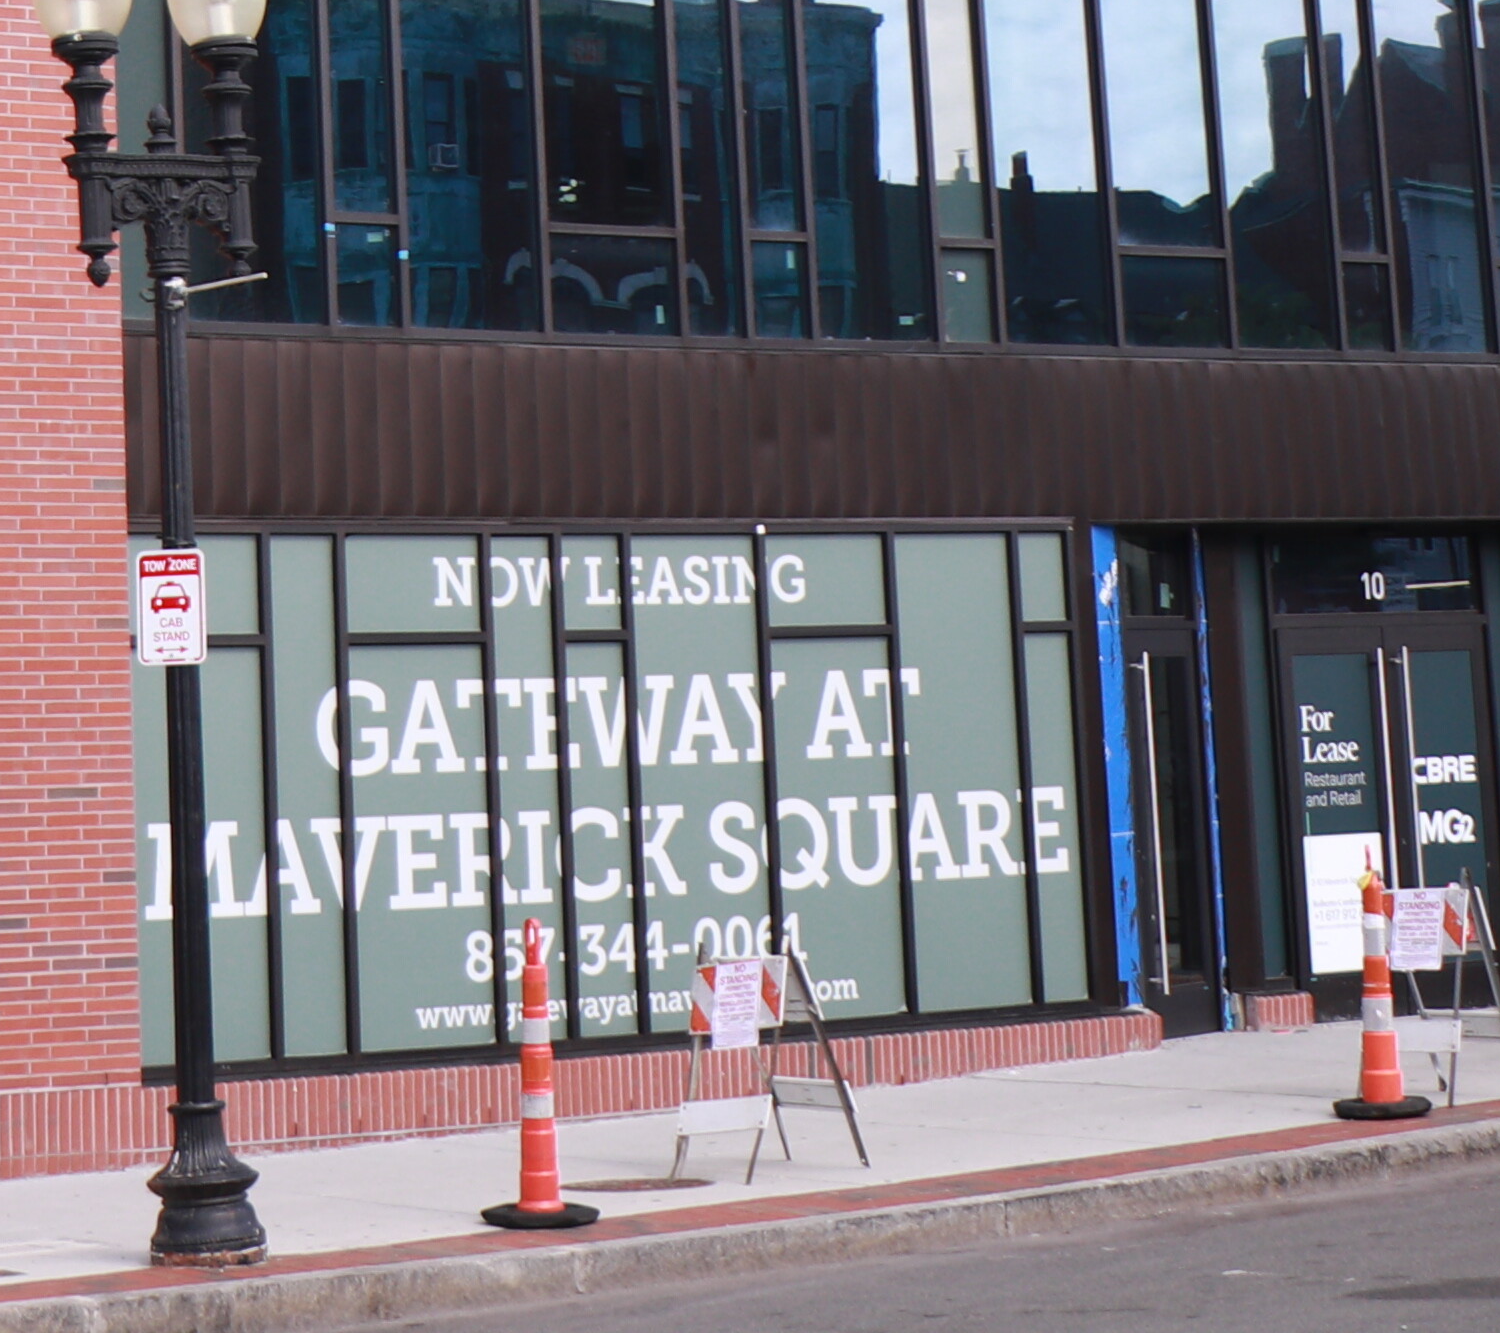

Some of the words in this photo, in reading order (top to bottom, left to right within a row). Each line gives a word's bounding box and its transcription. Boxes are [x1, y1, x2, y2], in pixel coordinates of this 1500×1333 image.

[143, 560, 166, 572] TOW
[168, 558, 197, 571] ZONE
[432, 555, 570, 607] NOW
[584, 554, 807, 606] LEASING
[1361, 572, 1385, 600] 10
[159, 617, 183, 628] CAB
[153, 631, 190, 642] STAND
[316, 672, 788, 776] GATEWAY
[806, 667, 920, 759] AT
[1300, 705, 1334, 733] For
[1302, 736, 1360, 763] Lease
[1305, 771, 1366, 787] Restaurant
[1412, 754, 1477, 785] CBRE
[1306, 791, 1328, 808] and
[1330, 789, 1363, 806] Retail
[1419, 809, 1477, 845] MG2
[145, 806, 688, 921] MAVERICK
[708, 786, 1070, 895] SQUARE
[1399, 901, 1440, 910] STANDING
[1413, 892, 1427, 900] NO
[734, 964, 746, 972] NO
[719, 973, 758, 986] STANDING
